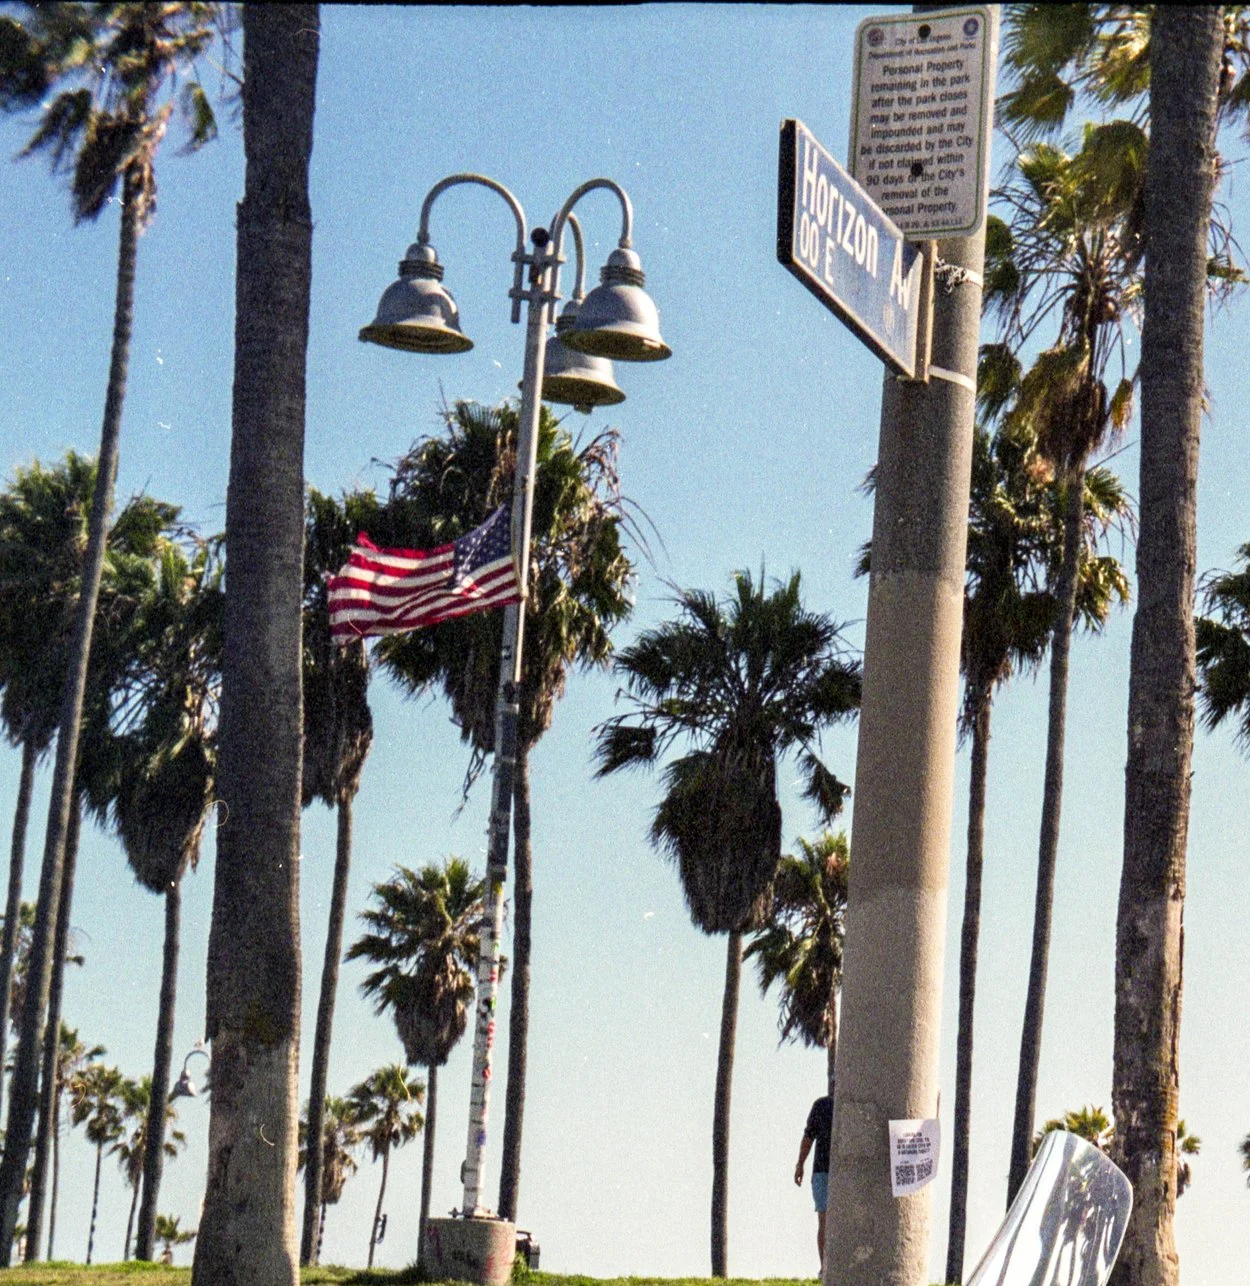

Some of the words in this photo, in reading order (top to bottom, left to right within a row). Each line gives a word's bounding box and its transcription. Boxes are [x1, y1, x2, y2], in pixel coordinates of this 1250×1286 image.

[882, 62, 923, 77] Personal
[927, 59, 964, 74] Property
[871, 80, 917, 93] remaining
[920, 78, 929, 88] in
[932, 77, 946, 87] the
[950, 73, 970, 87] park
[872, 97, 894, 109] after
[898, 95, 912, 106] the
[916, 92, 936, 106] park
[939, 90, 968, 102] closes
[870, 113, 890, 126] may
[893, 111, 905, 122] be
[908, 107, 947, 120] removed
[950, 105, 967, 117] and
[926, 123, 943, 135] and
[947, 121, 965, 133] may
[861, 144, 872, 156] be
[876, 140, 922, 154] discarded
[925, 139, 935, 152] by
[938, 138, 953, 149] the
[956, 135, 973, 149] City
[878, 158, 894, 170] not
[937, 151, 964, 165] within
[866, 174, 880, 187] 90
[883, 173, 904, 187] days
[921, 170, 935, 182] the
[938, 167, 965, 181] City's
[881, 187, 918, 201] removal
[921, 186, 930, 197] of
[934, 184, 949, 196] the
[802, 140, 879, 279] Horizon
[824, 236, 836, 285] E
